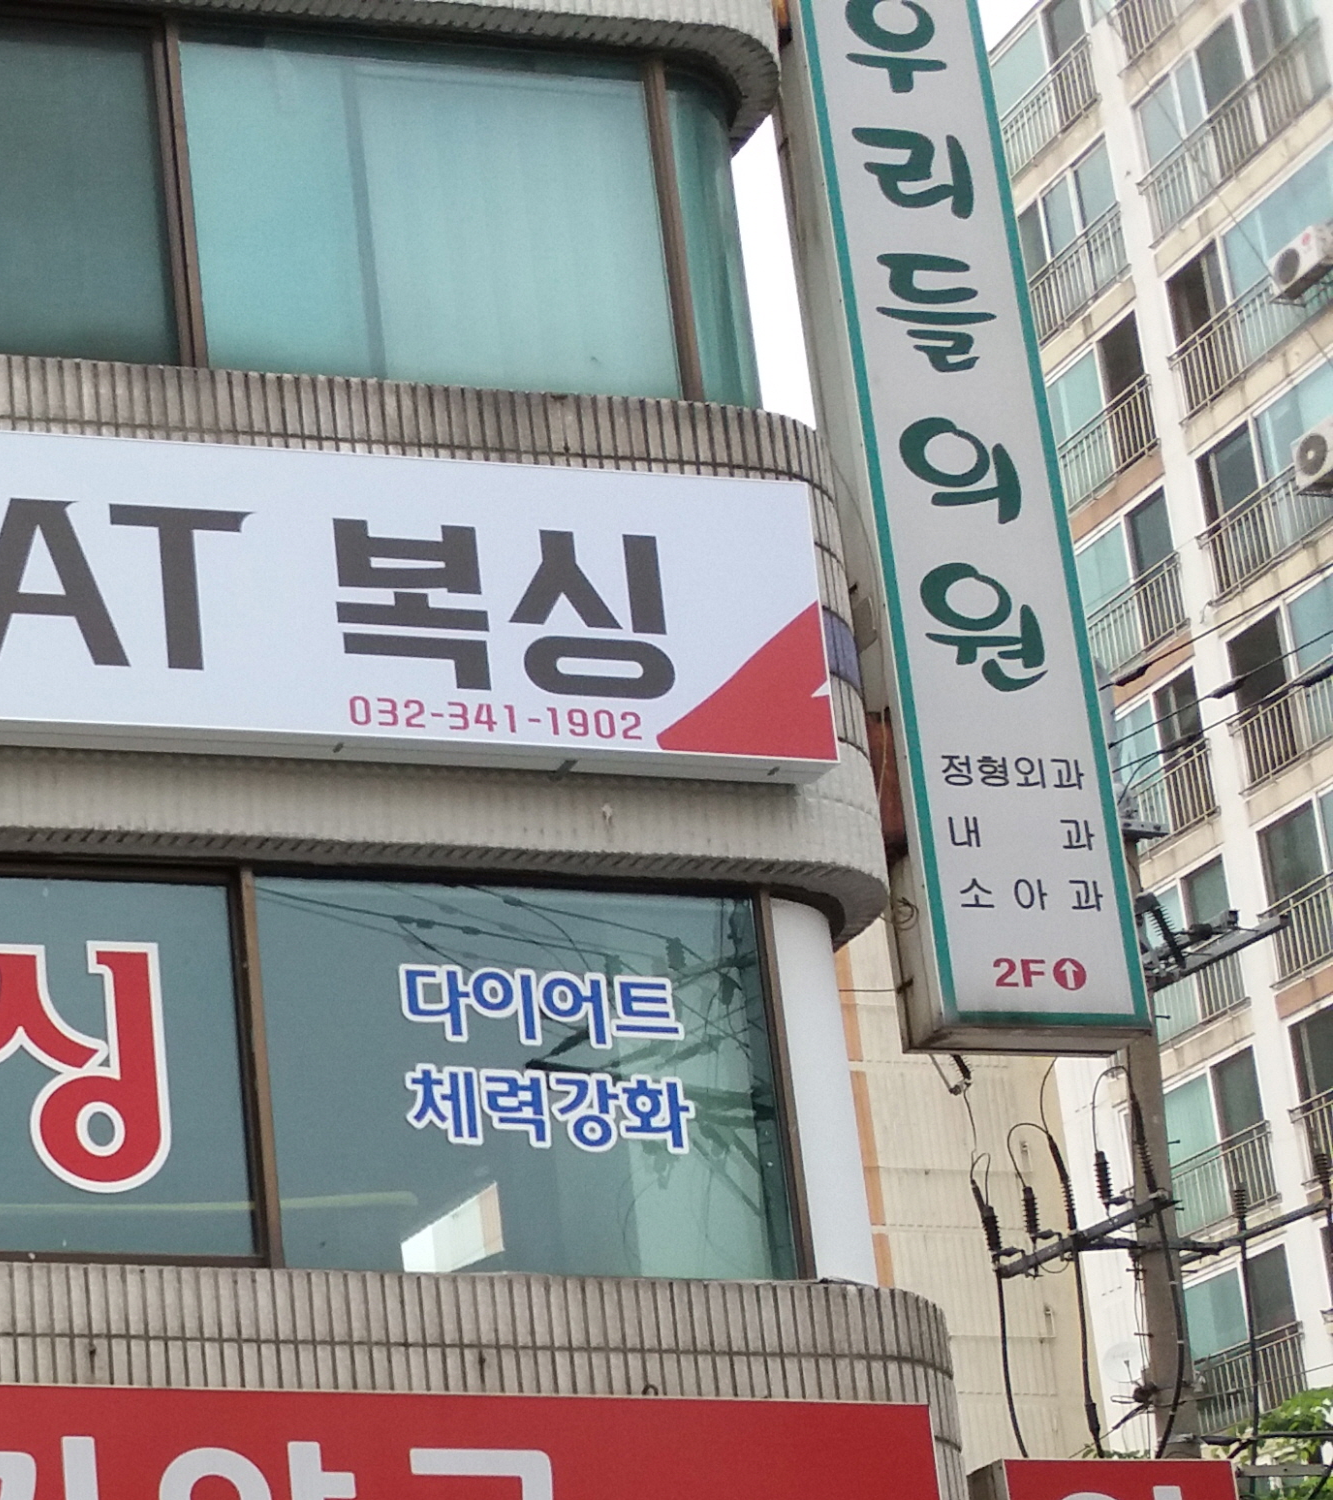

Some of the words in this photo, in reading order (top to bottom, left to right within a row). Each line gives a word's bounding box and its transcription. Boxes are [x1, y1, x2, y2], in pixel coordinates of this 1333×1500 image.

[332, 516, 679, 699] 복싱
[348, 693, 646, 741] 032-341-1902
[940, 754, 1085, 790] 정형외과
[397, 961, 684, 1047] 다이어트
[992, 957, 1046, 988] 2F
[402, 1061, 696, 1157] 체력강화
